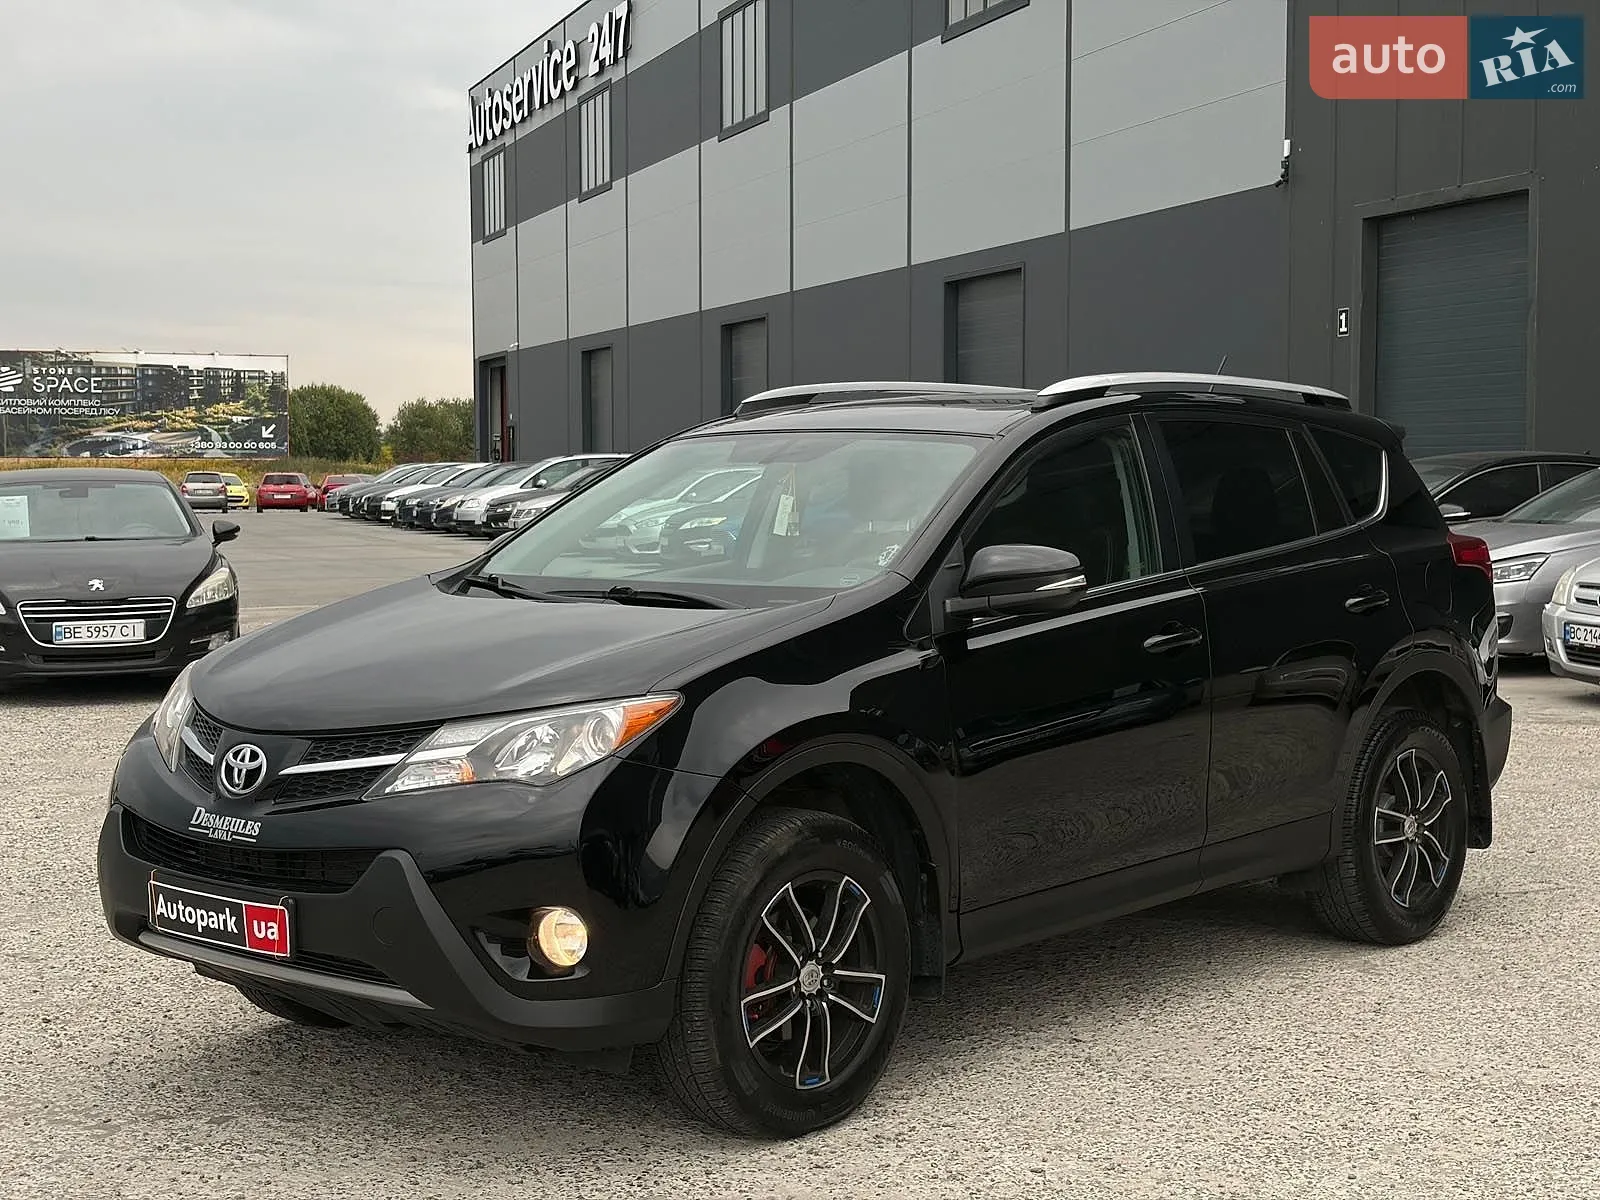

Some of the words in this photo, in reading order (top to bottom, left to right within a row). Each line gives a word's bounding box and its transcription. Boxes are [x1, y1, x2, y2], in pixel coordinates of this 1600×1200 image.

[467, 39, 577, 150] Autoservice
[588, 0, 629, 77] 24/7
[1339, 312, 1348, 333] 1
[32, 367, 74, 375] STONE
[33, 377, 102, 393] SPACE
[0, 397, 47, 407] ИТЛОВИЙ
[48, 399, 101, 407] КОМПЛЕКС
[0, 406, 52, 415] БАСЕЙНОМ
[53, 407, 98, 415] ПОСЕРЕД
[64, 627, 83, 639] BE
[86, 625, 116, 638] 5957
[1570, 626, 1582, 640] BC
[1583, 628, 1600, 643] 214
[208, 827, 232, 842] LAVAL
[156, 893, 239, 934] Autopark
[253, 918, 279, 941] ua
